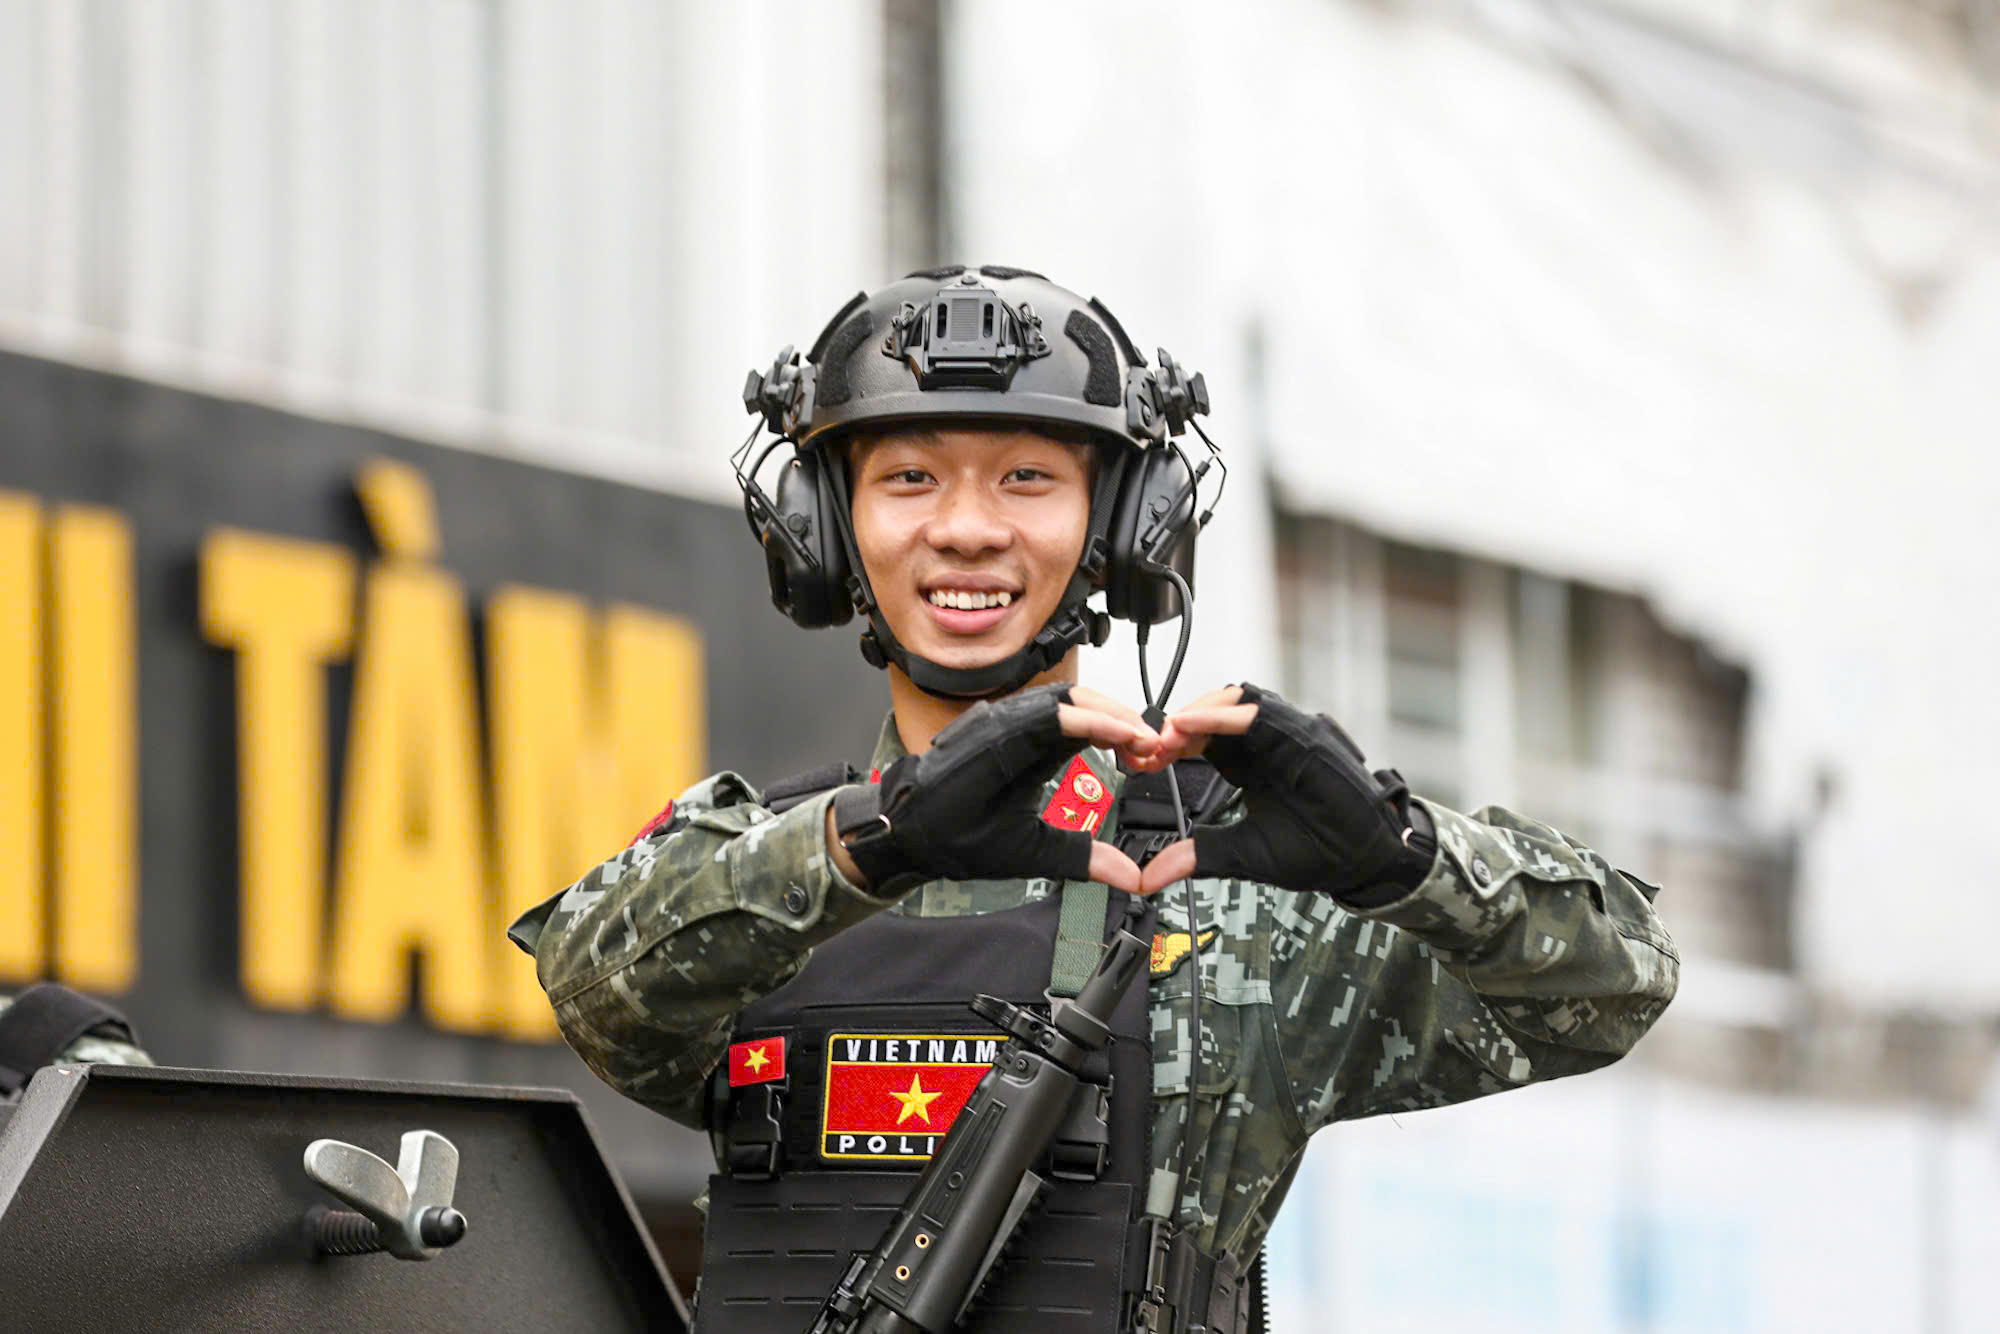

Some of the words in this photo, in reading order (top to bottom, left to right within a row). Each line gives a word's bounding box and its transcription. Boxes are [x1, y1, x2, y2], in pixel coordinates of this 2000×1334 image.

[200, 458, 706, 1043] TÀM
[846, 1039, 997, 1063] VIETNAM
[838, 1135, 935, 1154] POLI
